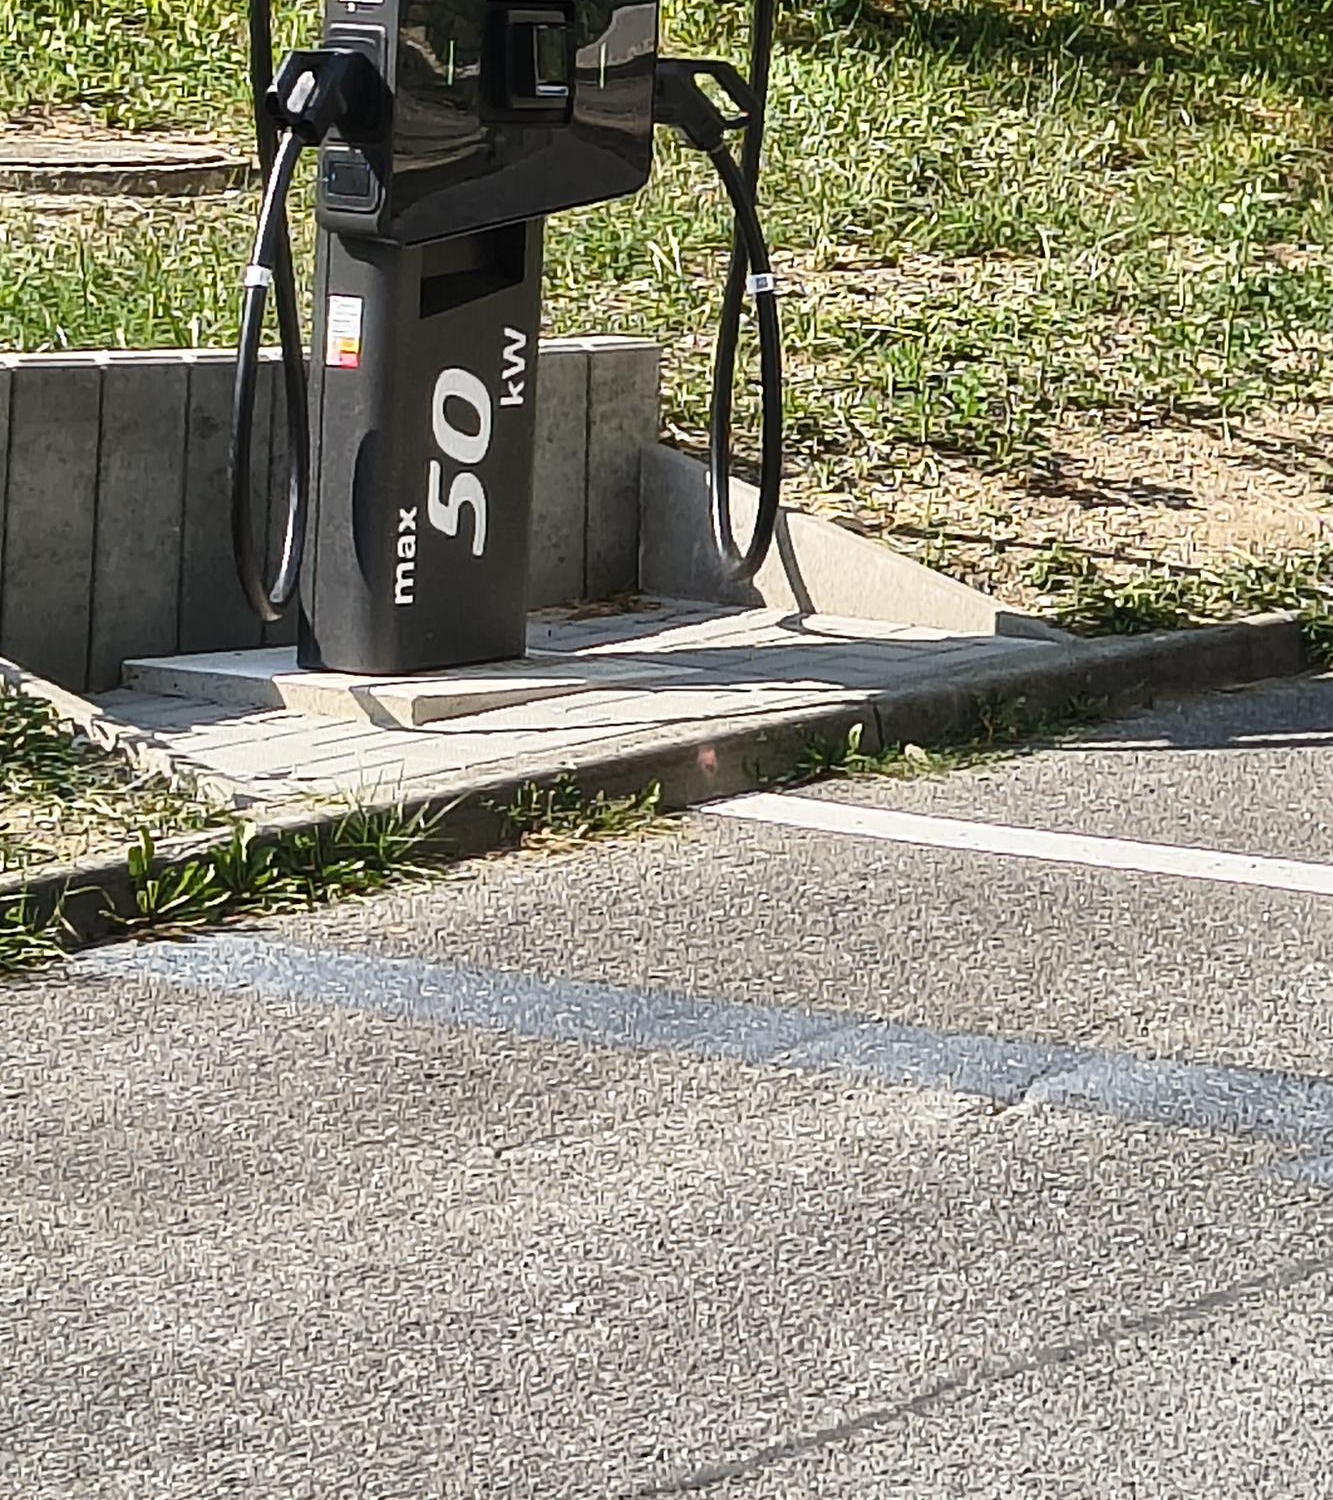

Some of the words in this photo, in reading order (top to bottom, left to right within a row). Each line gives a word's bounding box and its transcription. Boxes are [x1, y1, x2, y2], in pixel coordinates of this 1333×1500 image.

[395, 506, 418, 605] max
[427, 367, 493, 557] 50
[500, 327, 527, 407] kW
